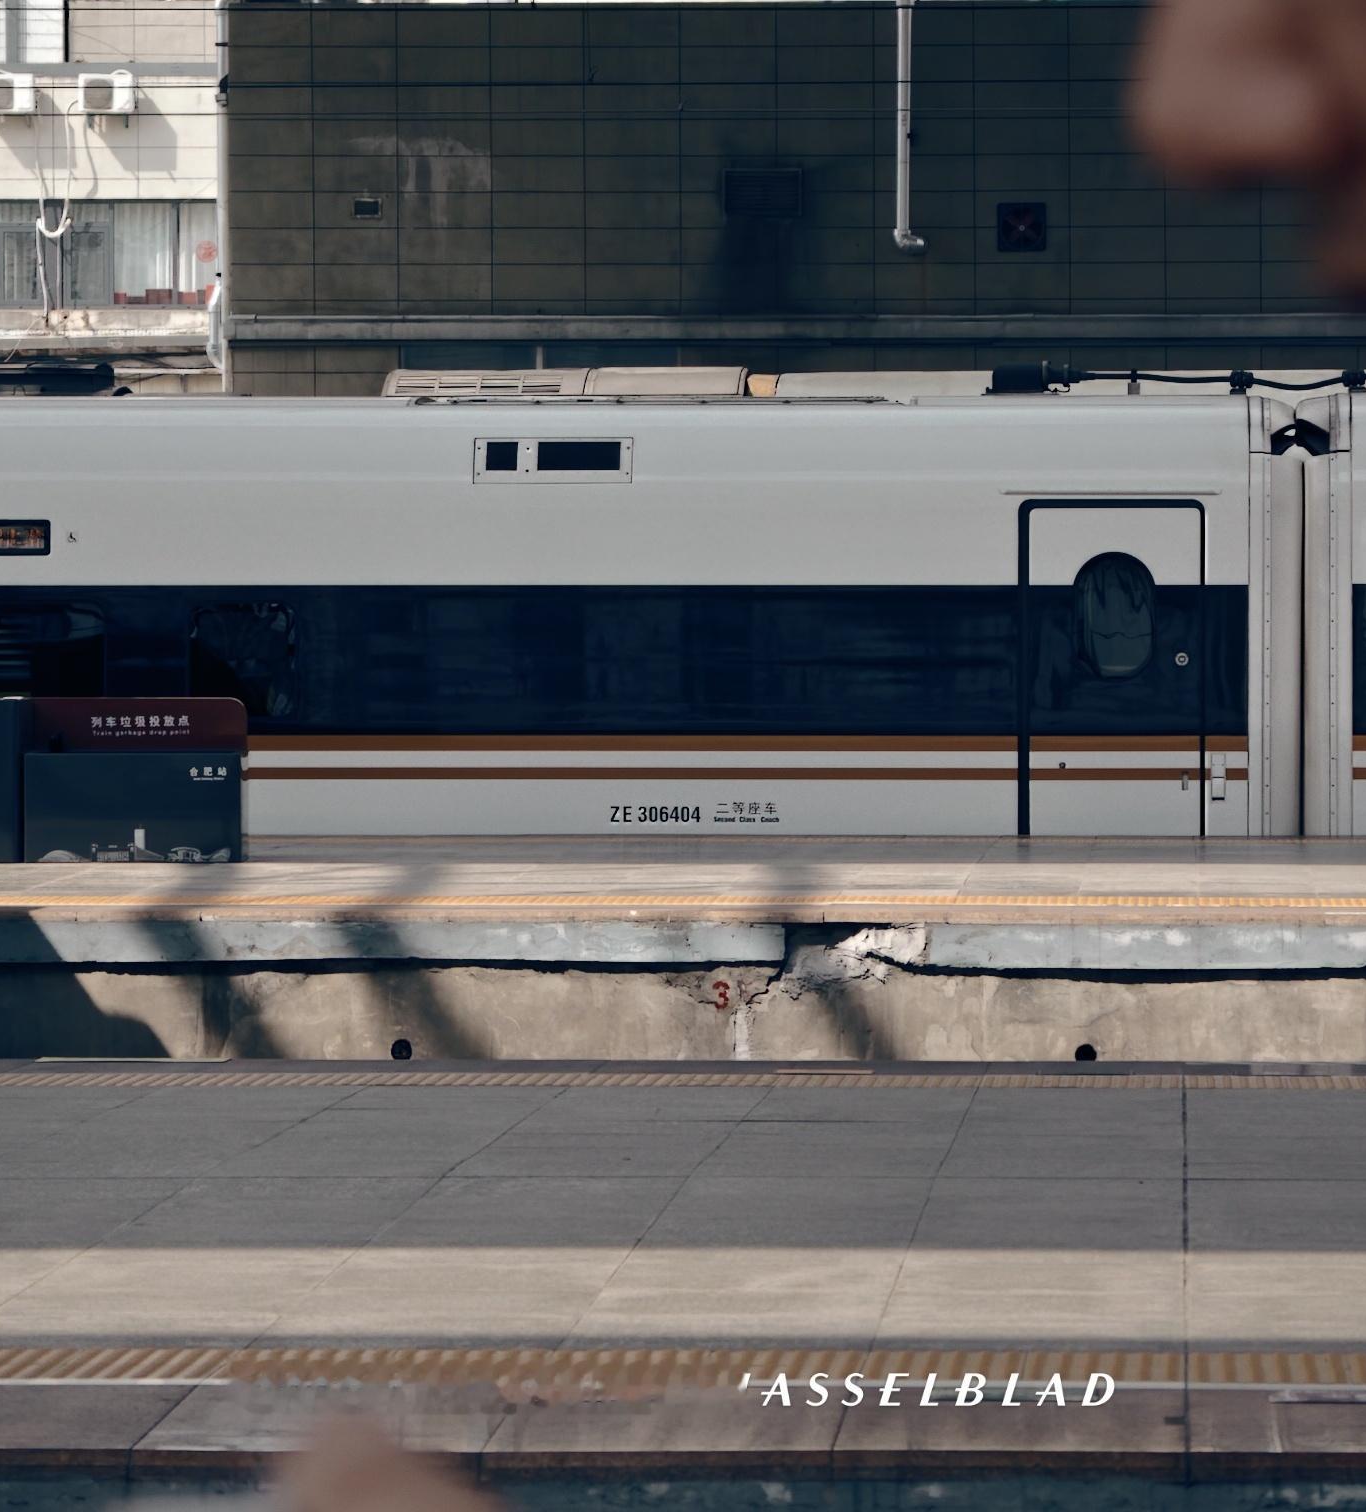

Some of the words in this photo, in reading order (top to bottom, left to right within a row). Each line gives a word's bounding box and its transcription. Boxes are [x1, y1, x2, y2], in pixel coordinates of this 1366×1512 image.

[91, 715, 190, 728] 列车垃圾投放点
[189, 766, 227, 777] 合肥站
[610, 806, 632, 822] ZE
[638, 806, 701, 822] 306404
[716, 802, 777, 815] 二等座车
[712, 981, 730, 1009] 3
